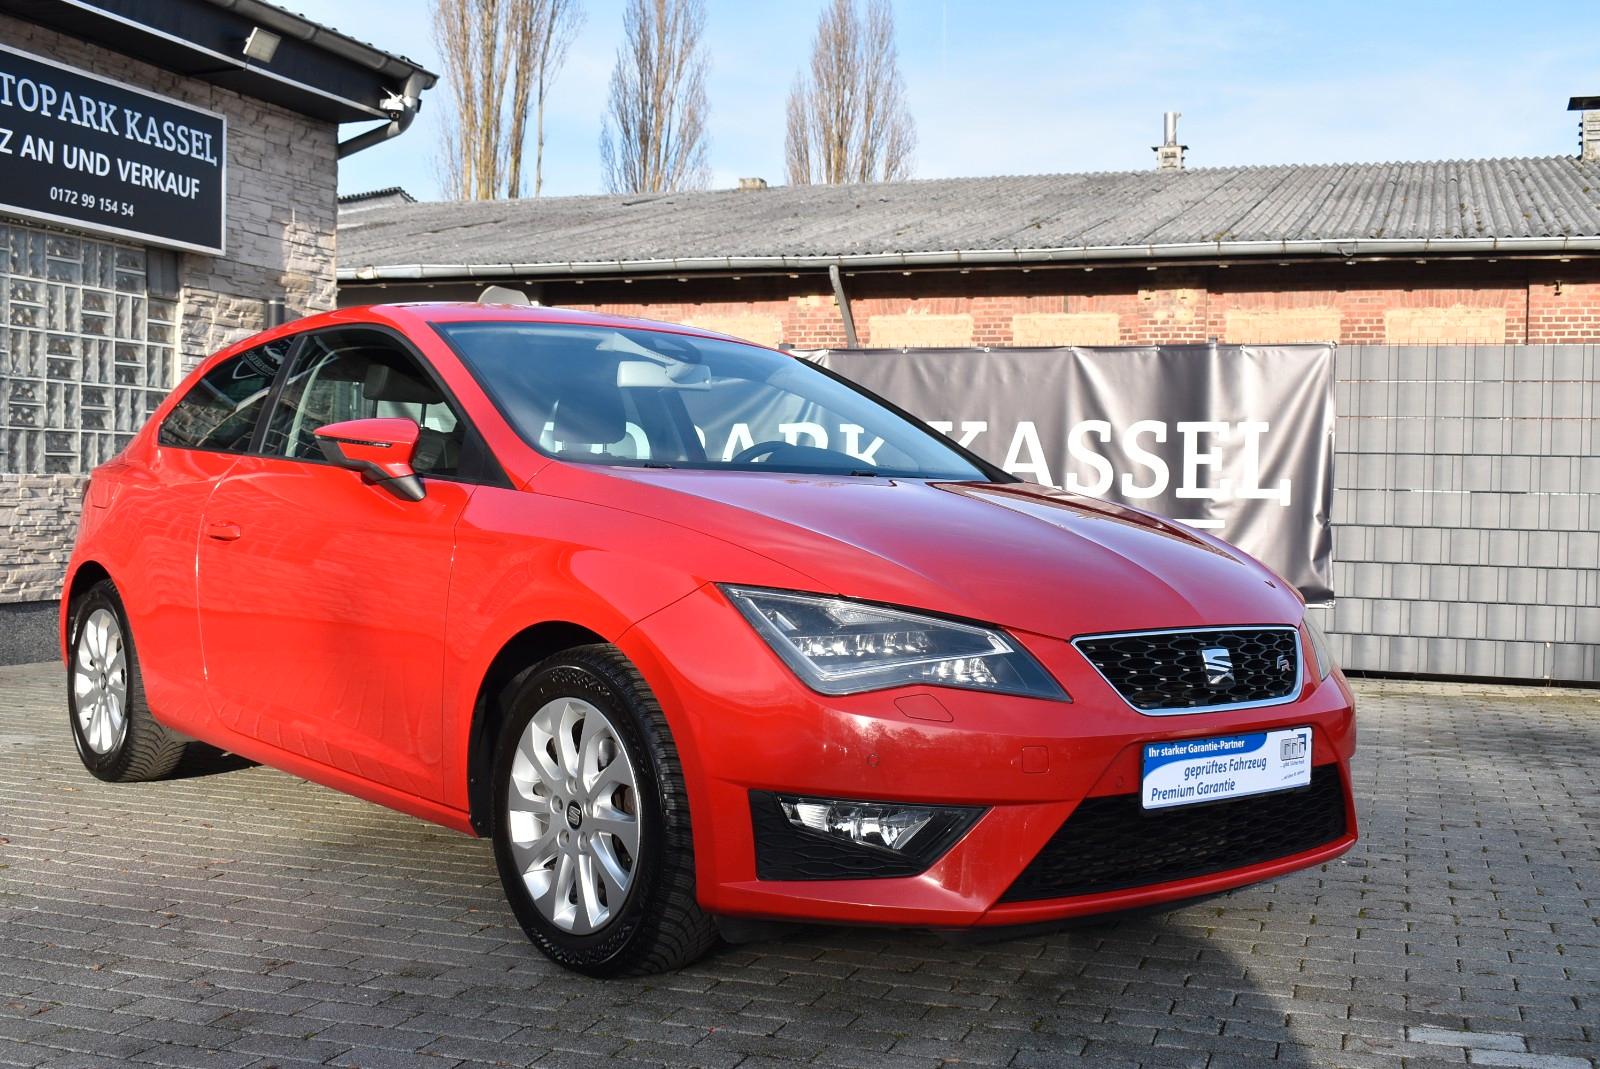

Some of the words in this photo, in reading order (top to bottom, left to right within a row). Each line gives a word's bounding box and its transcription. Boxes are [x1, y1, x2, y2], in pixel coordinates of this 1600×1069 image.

[0, 72, 119, 136] TOPARK
[124, 108, 218, 167] KASSEL
[20, 134, 54, 164] AN
[63, 144, 111, 177] UND
[117, 158, 200, 200] VERKAUF
[50, 186, 78, 205] 0172
[81, 193, 96, 209] 99
[99, 197, 118, 214] 154
[121, 202, 134, 217] 54
[1148, 747, 1160, 758] Ihr
[1161, 744, 1188, 757] starker
[1188, 740, 1245, 753] Garantie-Partner
[1184, 760, 1227, 780] geprüftes
[1229, 757, 1267, 771] Fahrzeug
[1151, 784, 1195, 801] Premium
[1196, 778, 1236, 796] Garantie
